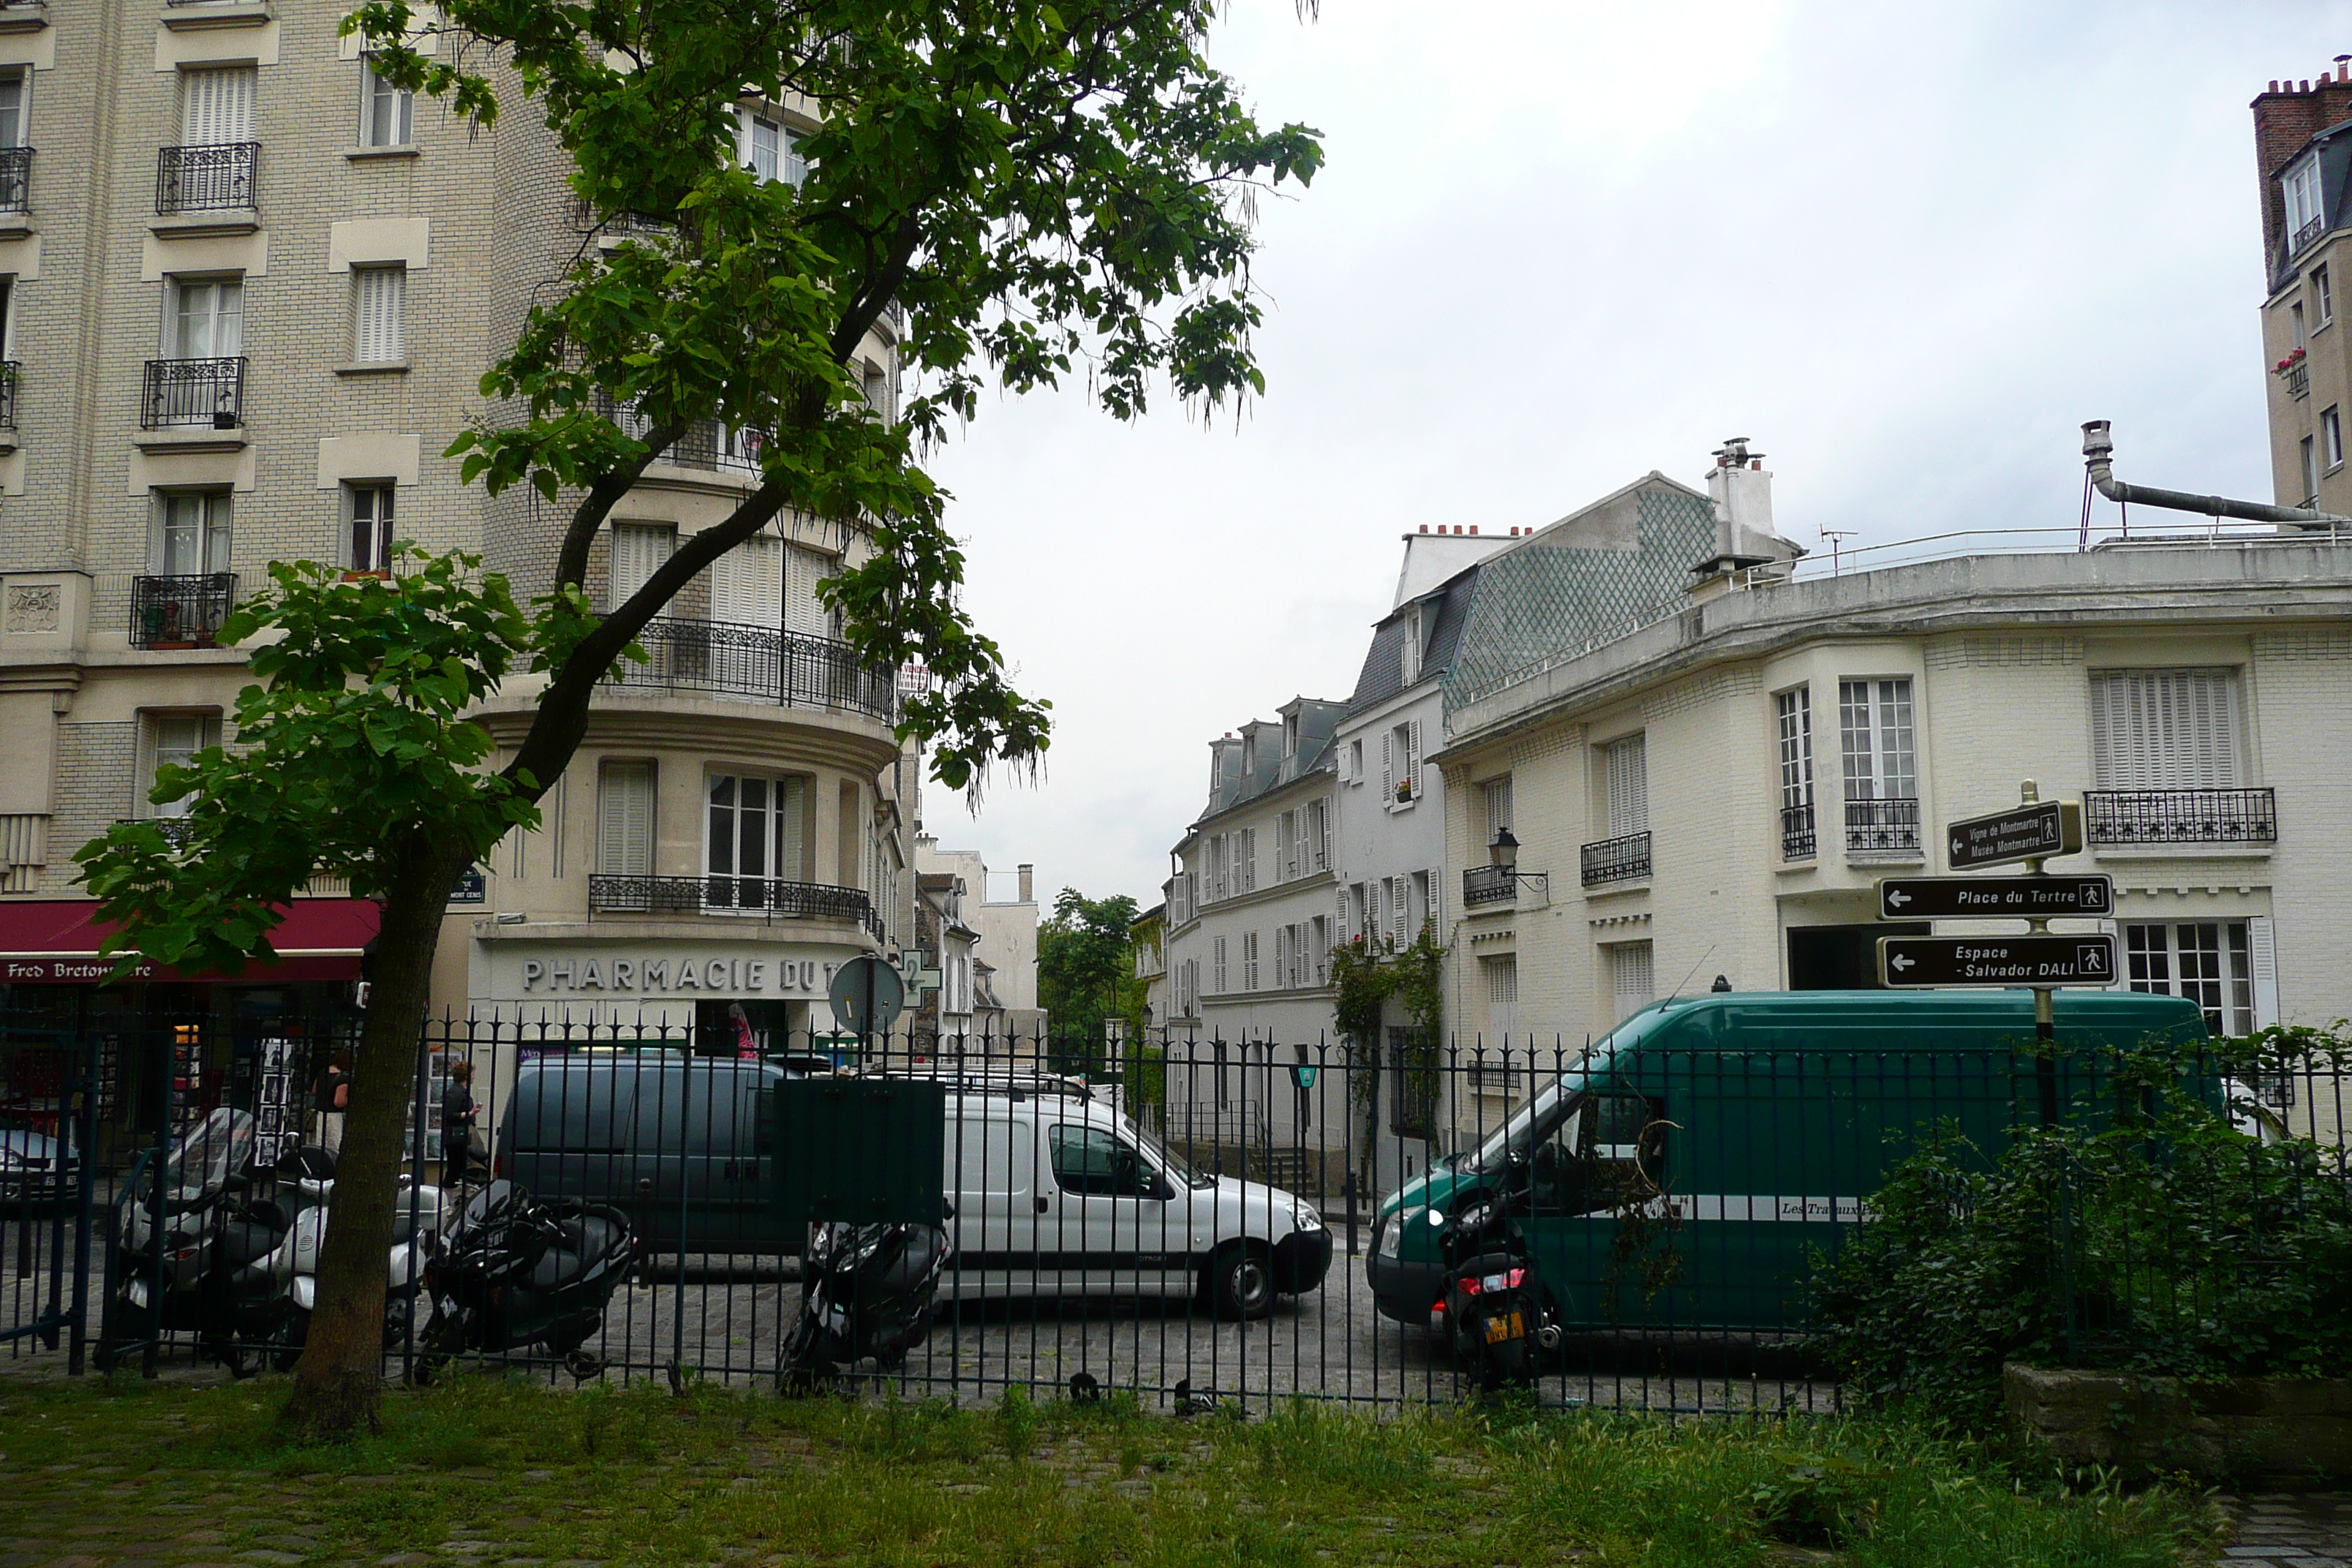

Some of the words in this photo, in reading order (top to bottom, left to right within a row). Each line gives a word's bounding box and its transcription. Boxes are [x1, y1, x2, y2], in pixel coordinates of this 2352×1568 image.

[1970, 828, 1987, 842] Vigne
[1990, 824, 1998, 836] de
[2000, 818, 2039, 834] Montmartre
[1971, 844, 1994, 857] Musée
[1997, 836, 2040, 853] Montmartre
[1958, 891, 1999, 904] Place
[2006, 890, 2023, 903] du
[2031, 890, 2076, 903] Tertre
[1956, 946, 2008, 961] Espace
[7, 962, 45, 978] Fred
[522, 958, 765, 992] PHARMACIE
[780, 960, 816, 990] DU
[2039, 962, 2074, 976] DALI
[1782, 1203, 1803, 1214] Les
[1807, 1203, 1859, 1215] Traaux
